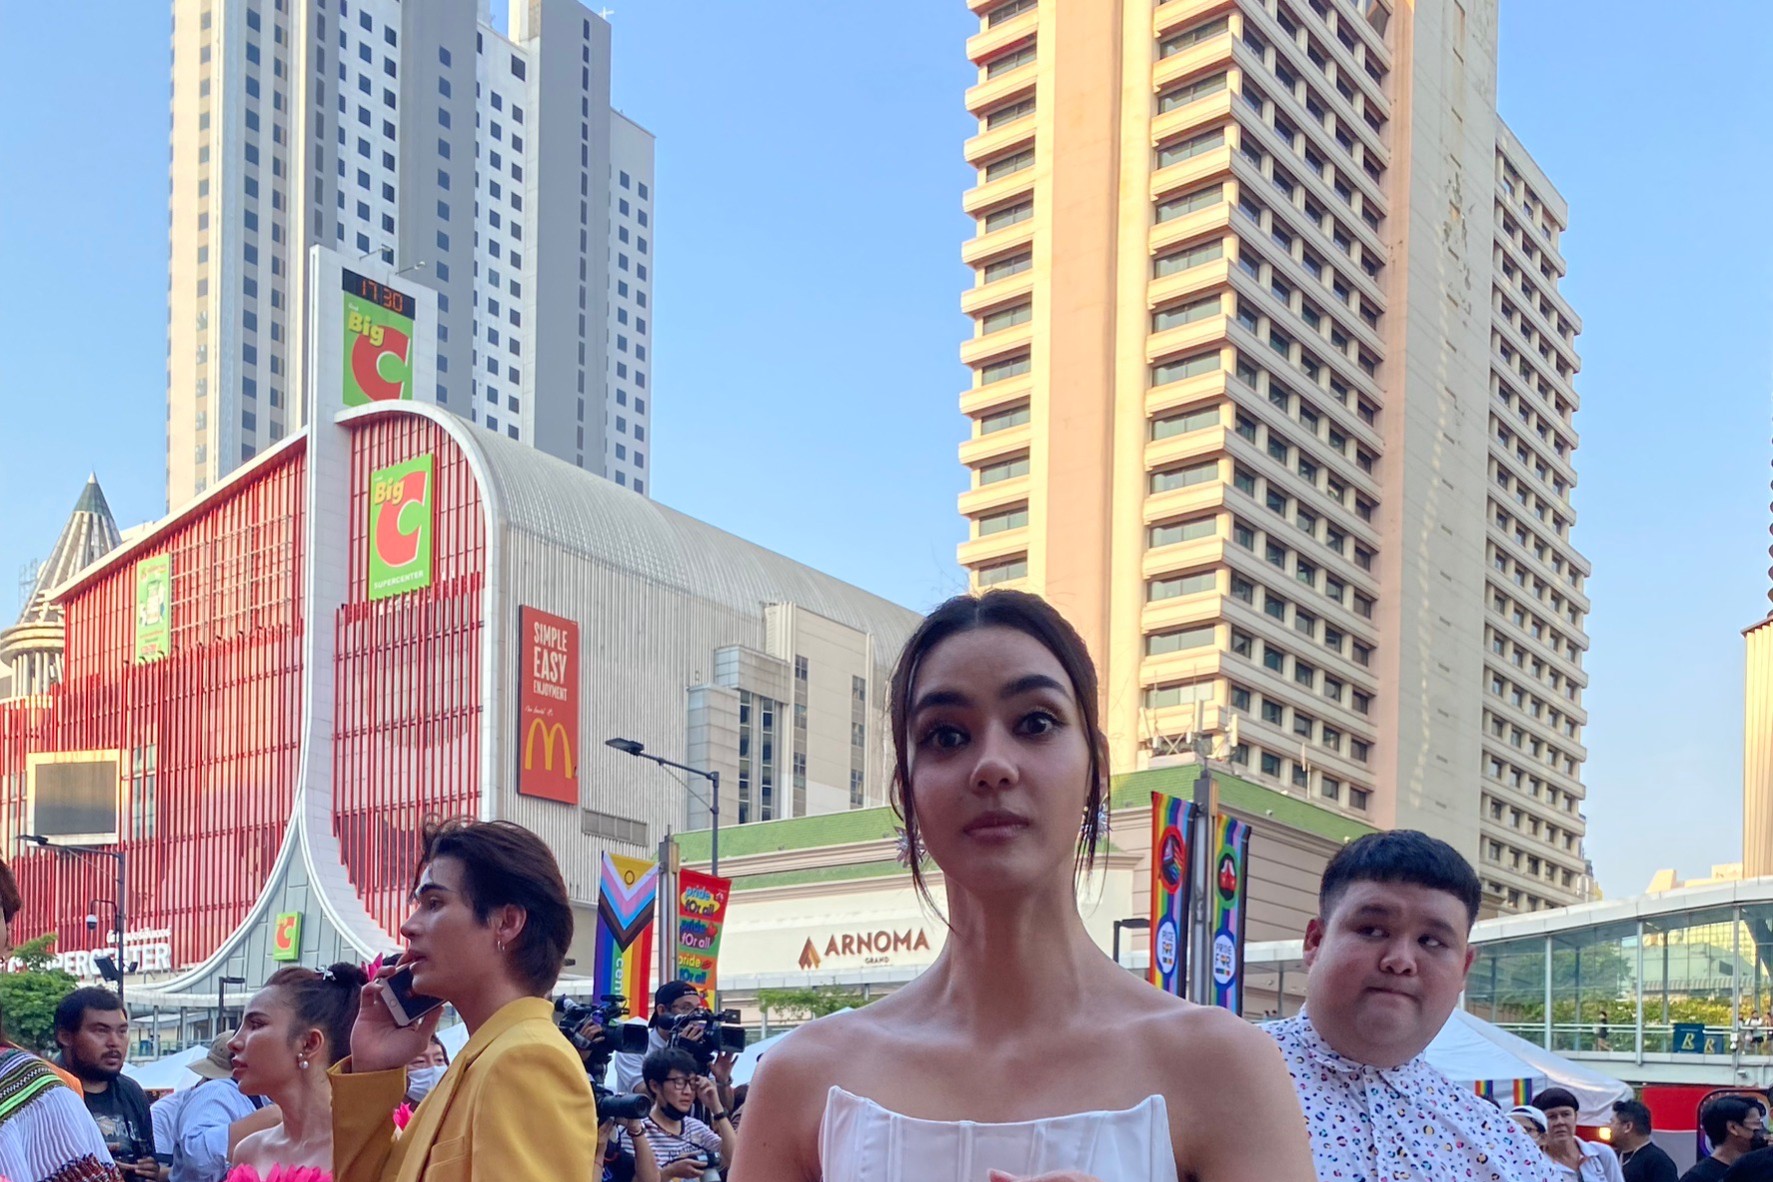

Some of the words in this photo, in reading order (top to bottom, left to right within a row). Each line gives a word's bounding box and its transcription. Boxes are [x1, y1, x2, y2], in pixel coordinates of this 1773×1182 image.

[348, 310, 385, 347] Big
[351, 324, 411, 402] C
[374, 477, 406, 505] Big
[375, 470, 428, 568] C
[533, 621, 568, 652] SIMPLE
[533, 645, 567, 685] EASY
[533, 679, 567, 701] ENJOYMENT
[684, 885, 711, 902] pride
[702, 904, 715, 917] all
[698, 936, 711, 949] all
[824, 927, 931, 957] ARNOMA
[865, 955, 890, 964] GRAND
